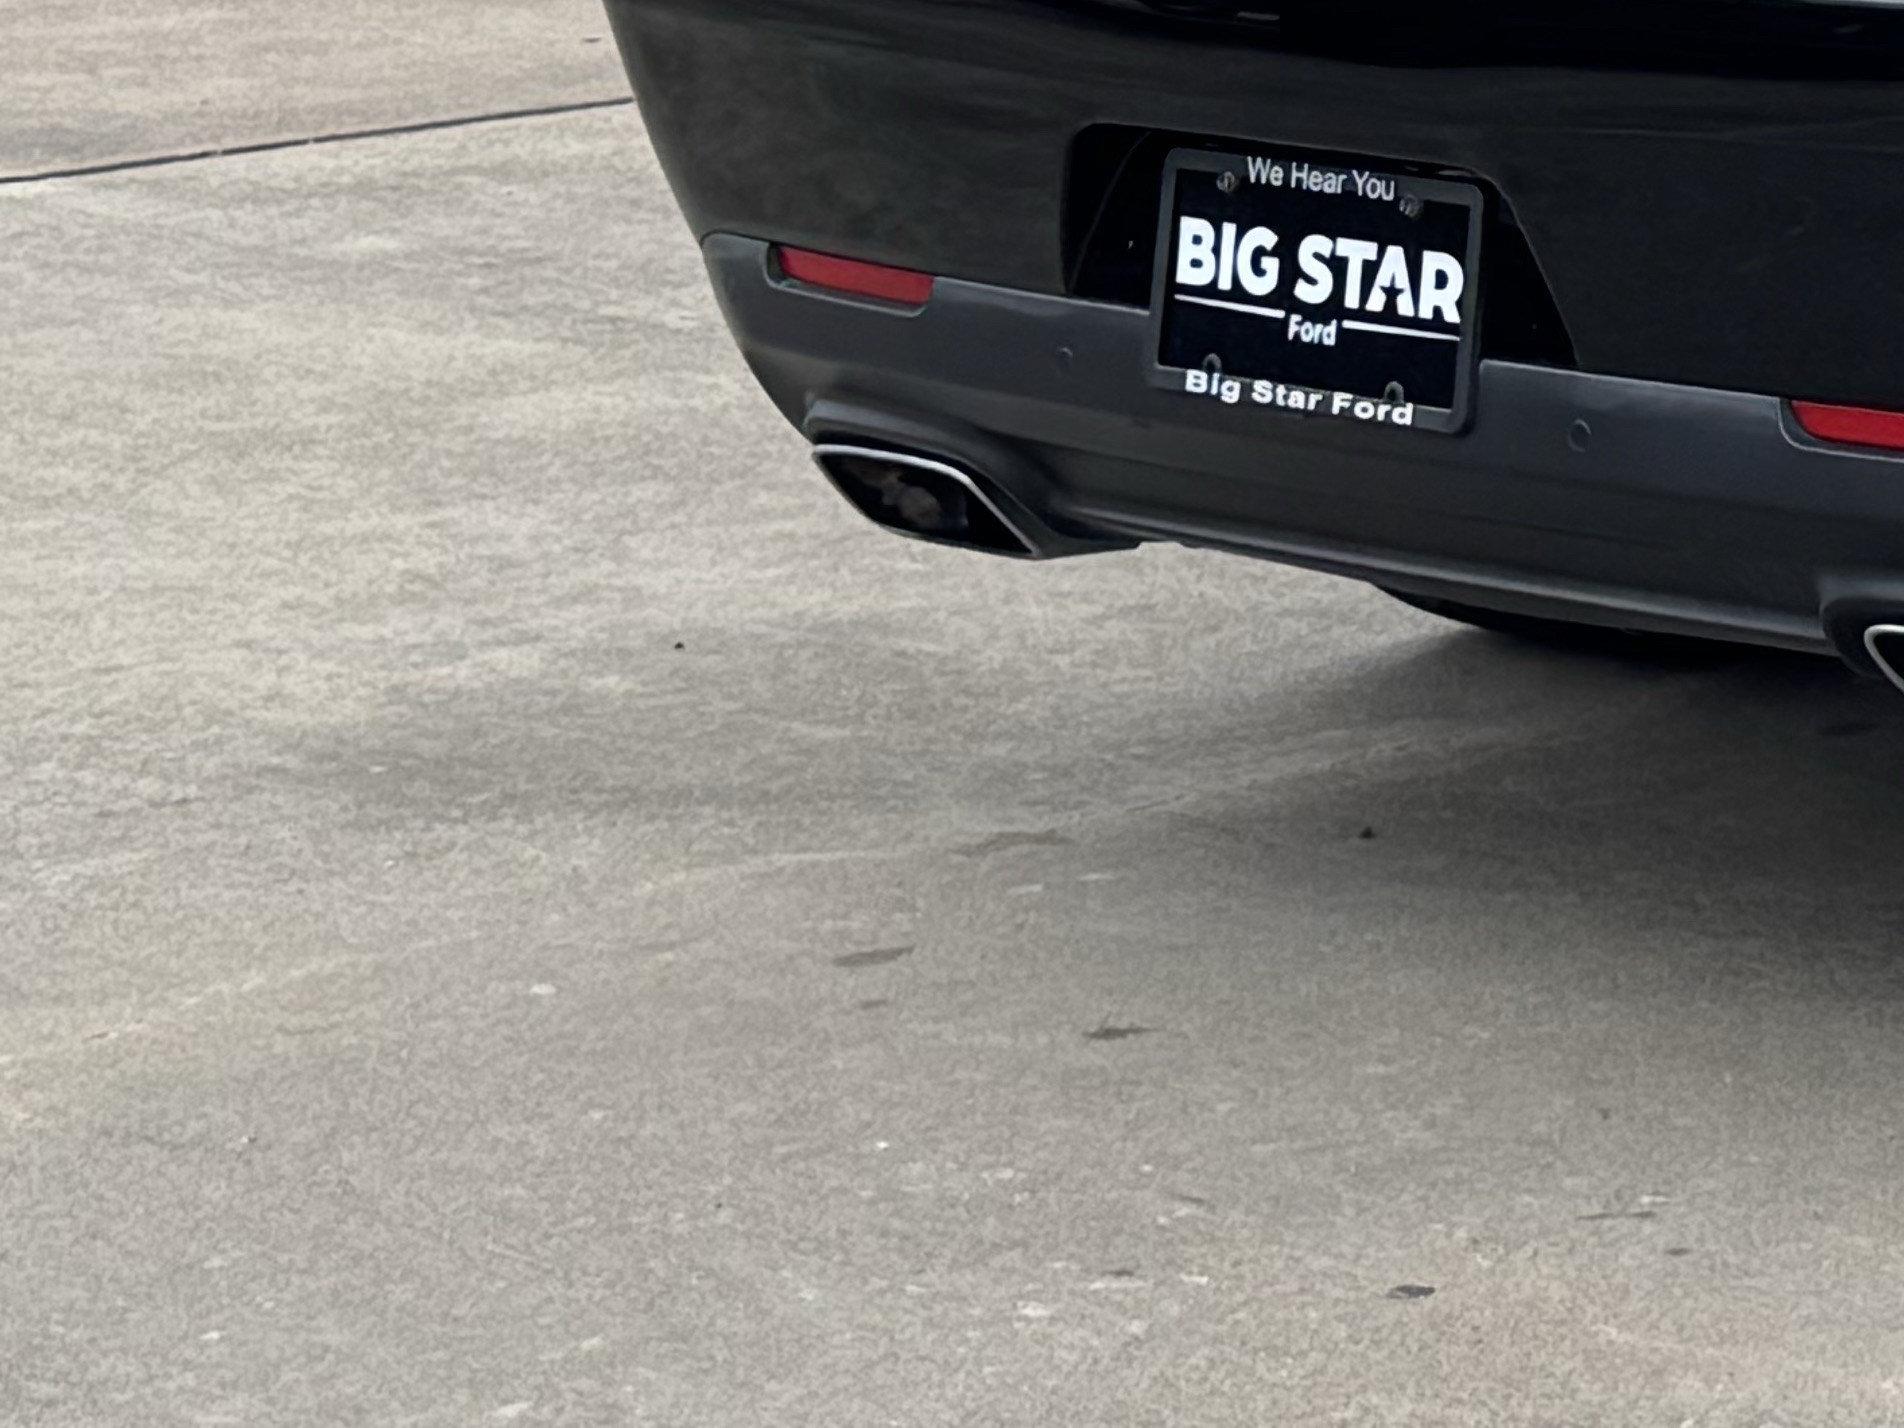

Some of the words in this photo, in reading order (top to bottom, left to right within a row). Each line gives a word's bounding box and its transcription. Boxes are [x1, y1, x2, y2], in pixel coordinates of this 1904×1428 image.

[1247, 156, 1284, 187] We
[1291, 162, 1348, 194] Hear
[1351, 169, 1395, 202] You
[1175, 215, 1280, 296] BIG
[1293, 233, 1464, 324] STAR
[1287, 312, 1338, 346] Ford
[1184, 368, 1242, 404] Big
[1251, 379, 1324, 411] Star
[1331, 391, 1414, 426] Ford
